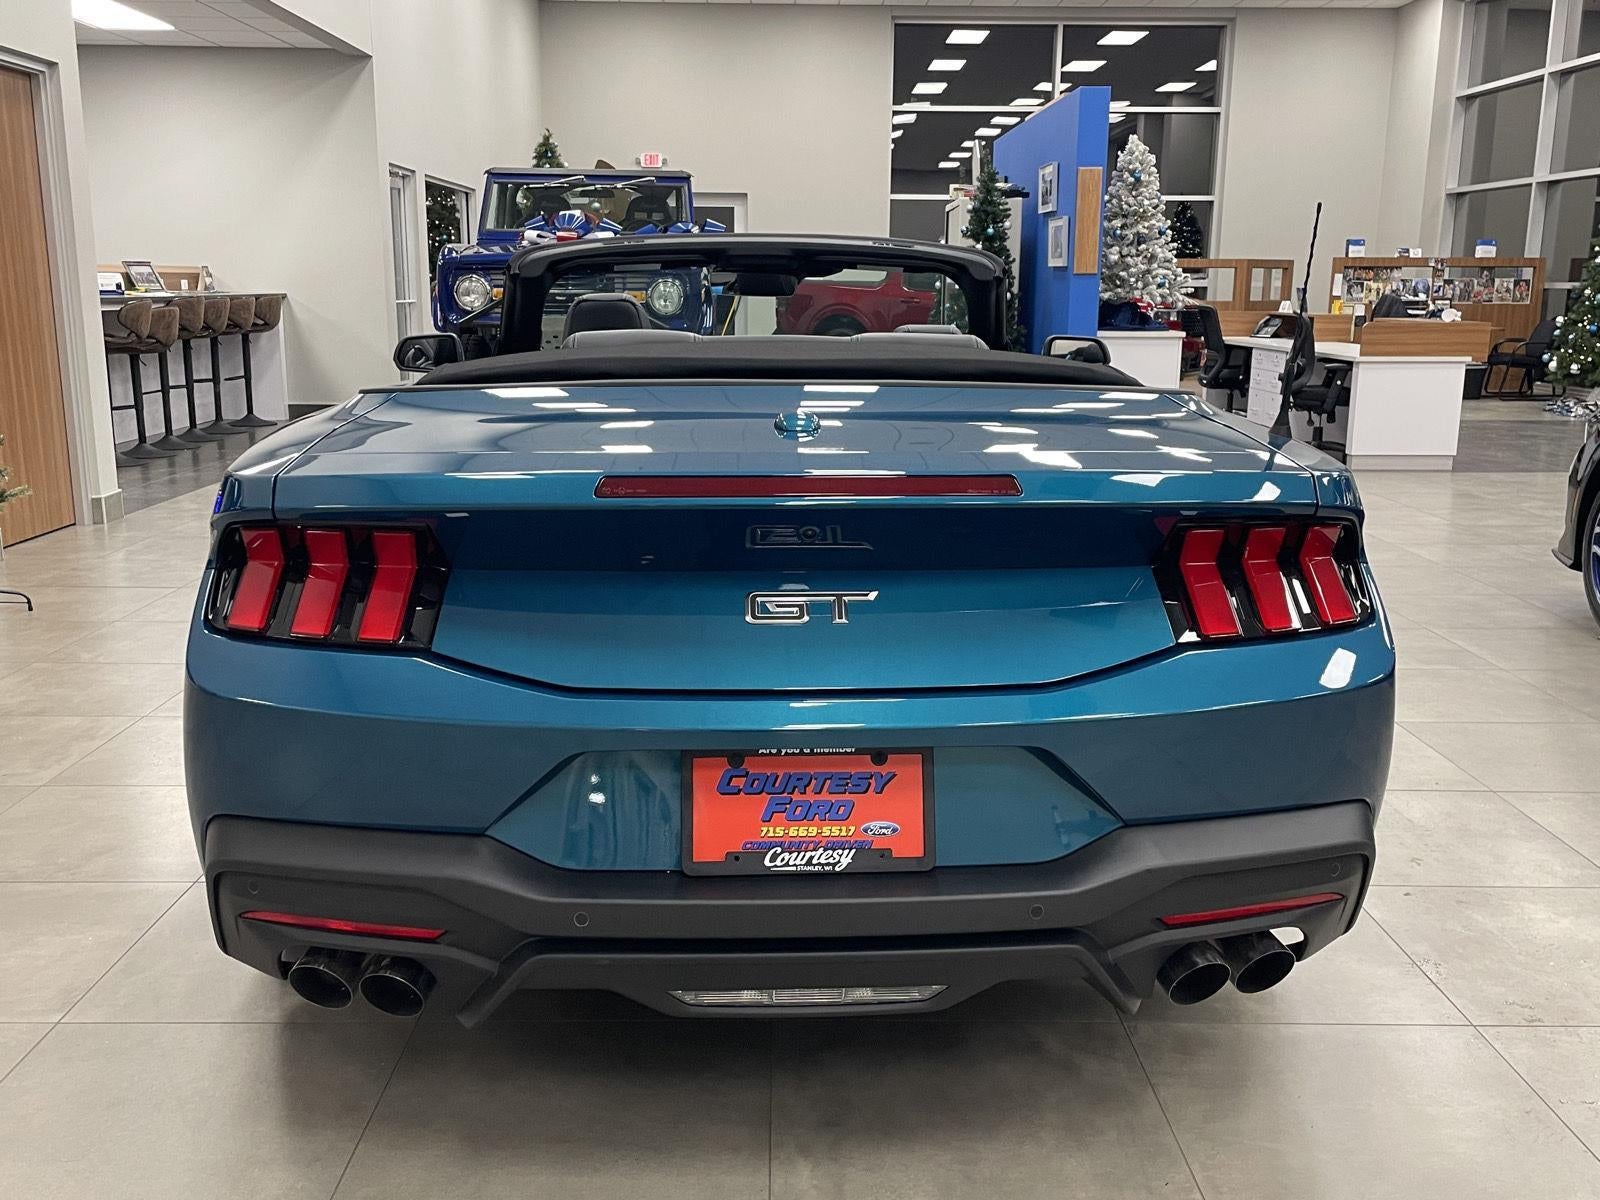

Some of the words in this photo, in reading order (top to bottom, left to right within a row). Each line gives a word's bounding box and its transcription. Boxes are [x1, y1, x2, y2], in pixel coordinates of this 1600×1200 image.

[644, 153, 659, 166] EXIT
[745, 591, 879, 625] GT
[781, 748, 800, 756] you
[760, 825, 856, 838] 715-669-5517
[867, 823, 893, 836] Ford
[823, 839, 874, 849] DRIVEN
[763, 846, 857, 872] Courtesy
